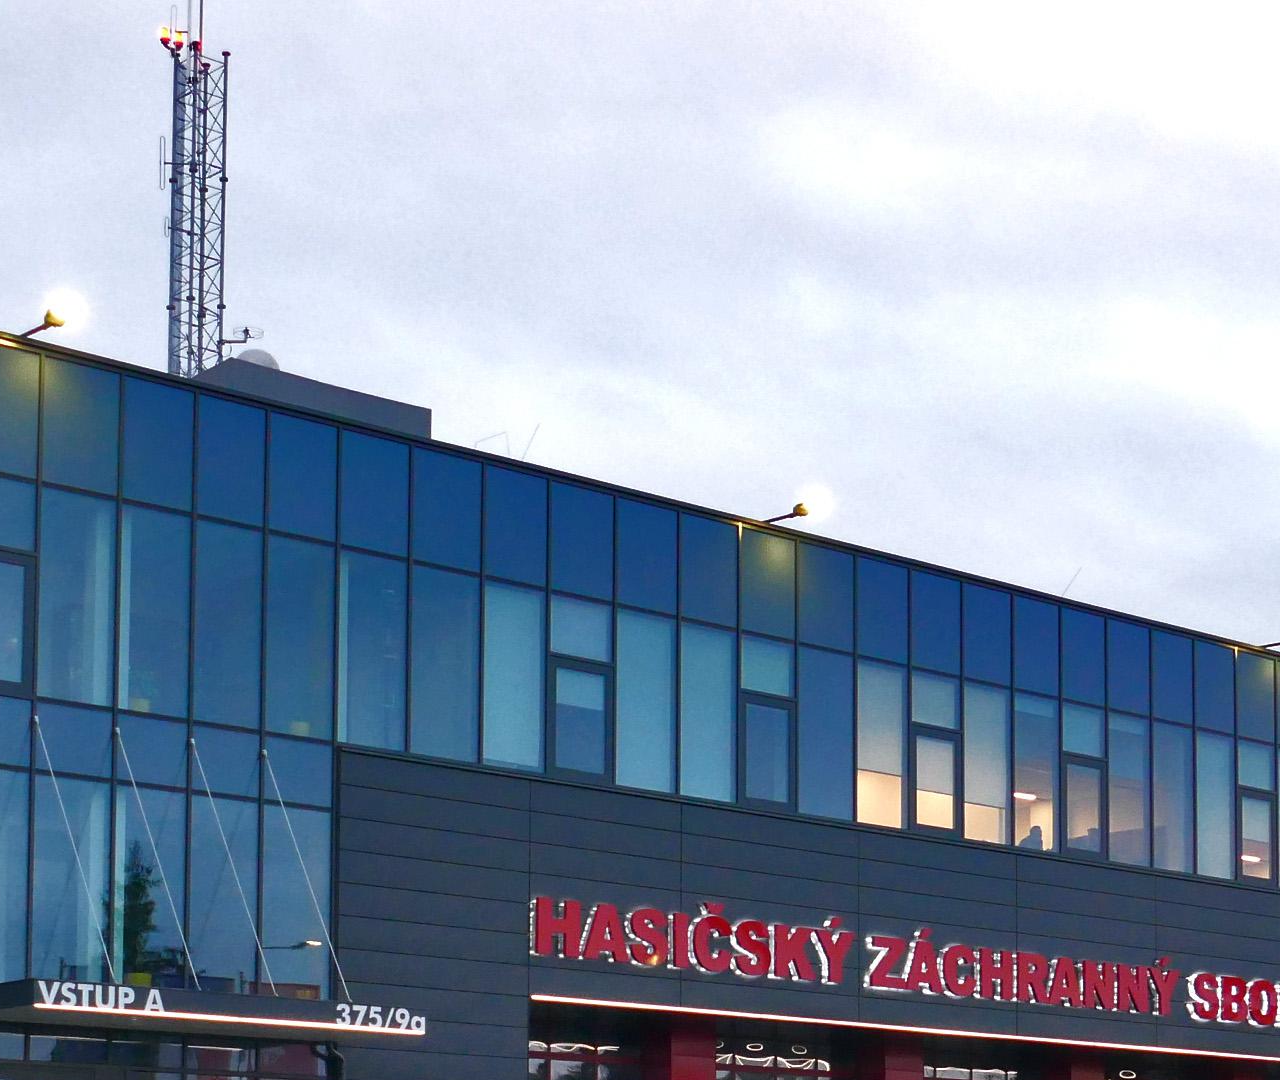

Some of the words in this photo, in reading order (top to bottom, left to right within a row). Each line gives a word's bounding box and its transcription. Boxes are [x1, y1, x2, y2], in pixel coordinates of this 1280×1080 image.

[529, 896, 854, 985] HASIČSKÝ
[863, 927, 1181, 1016] ZÁCHRANNÝ
[37, 980, 136, 1010] VSTUP
[144, 988, 166, 1013] A
[336, 1003, 426, 1032] 375/9a
